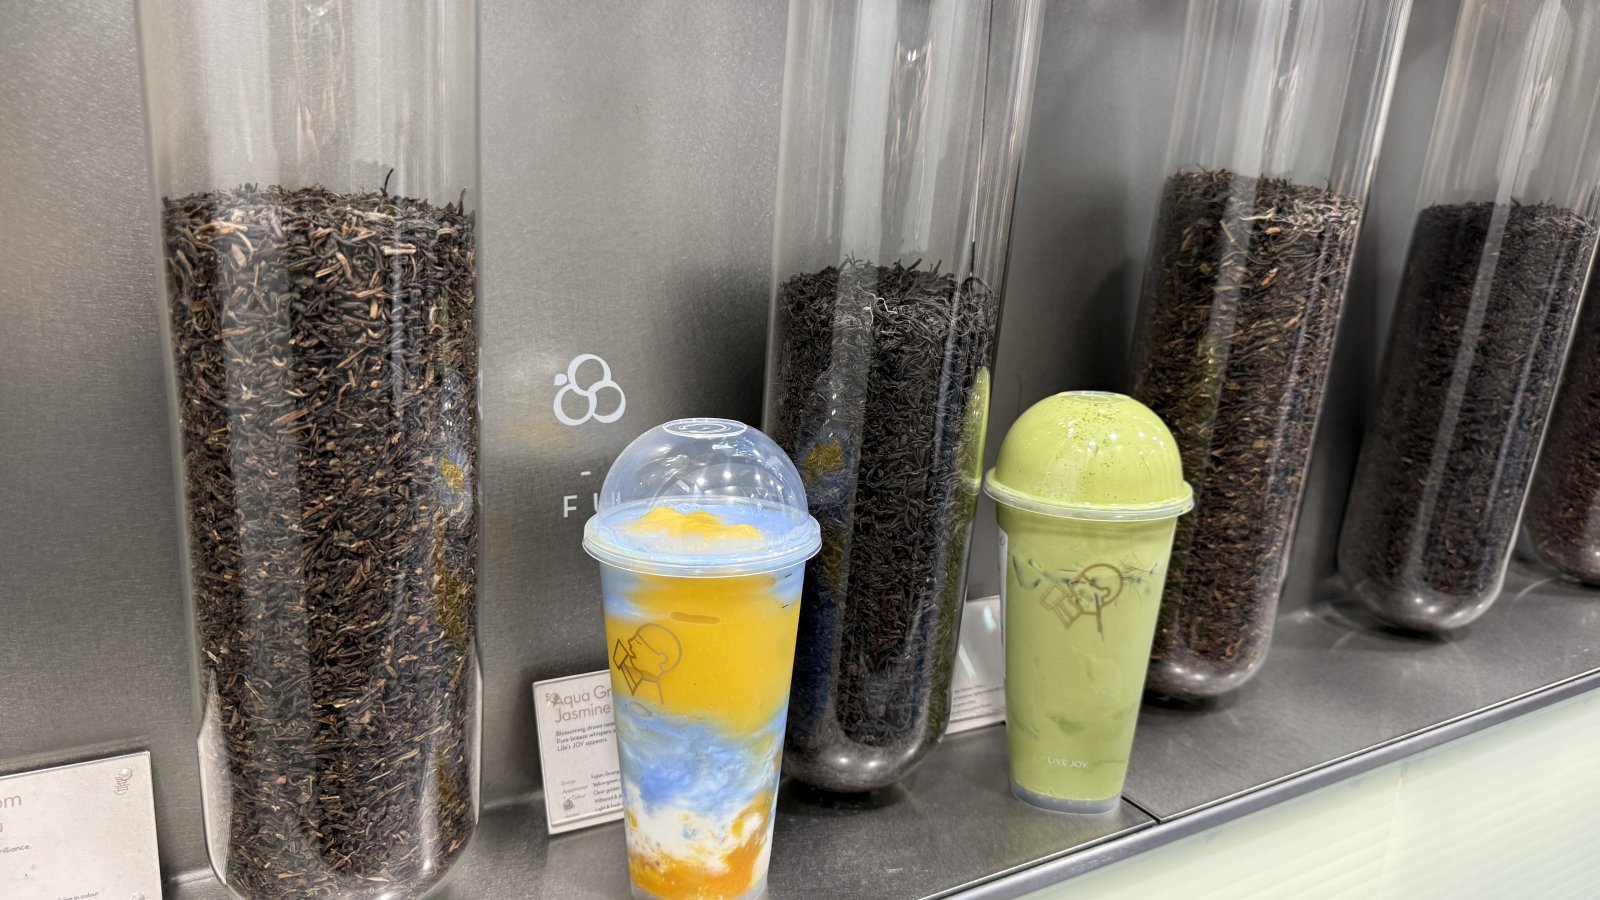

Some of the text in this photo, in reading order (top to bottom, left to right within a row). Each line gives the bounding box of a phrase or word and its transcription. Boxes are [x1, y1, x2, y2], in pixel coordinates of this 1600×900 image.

[552, 685, 612, 708] Aqua Gr
[555, 703, 611, 723] Jasmine
[573, 741, 585, 749] JOY
[1047, 756, 1088, 768] LIVE JOY
[80, 890, 99, 900] colour
